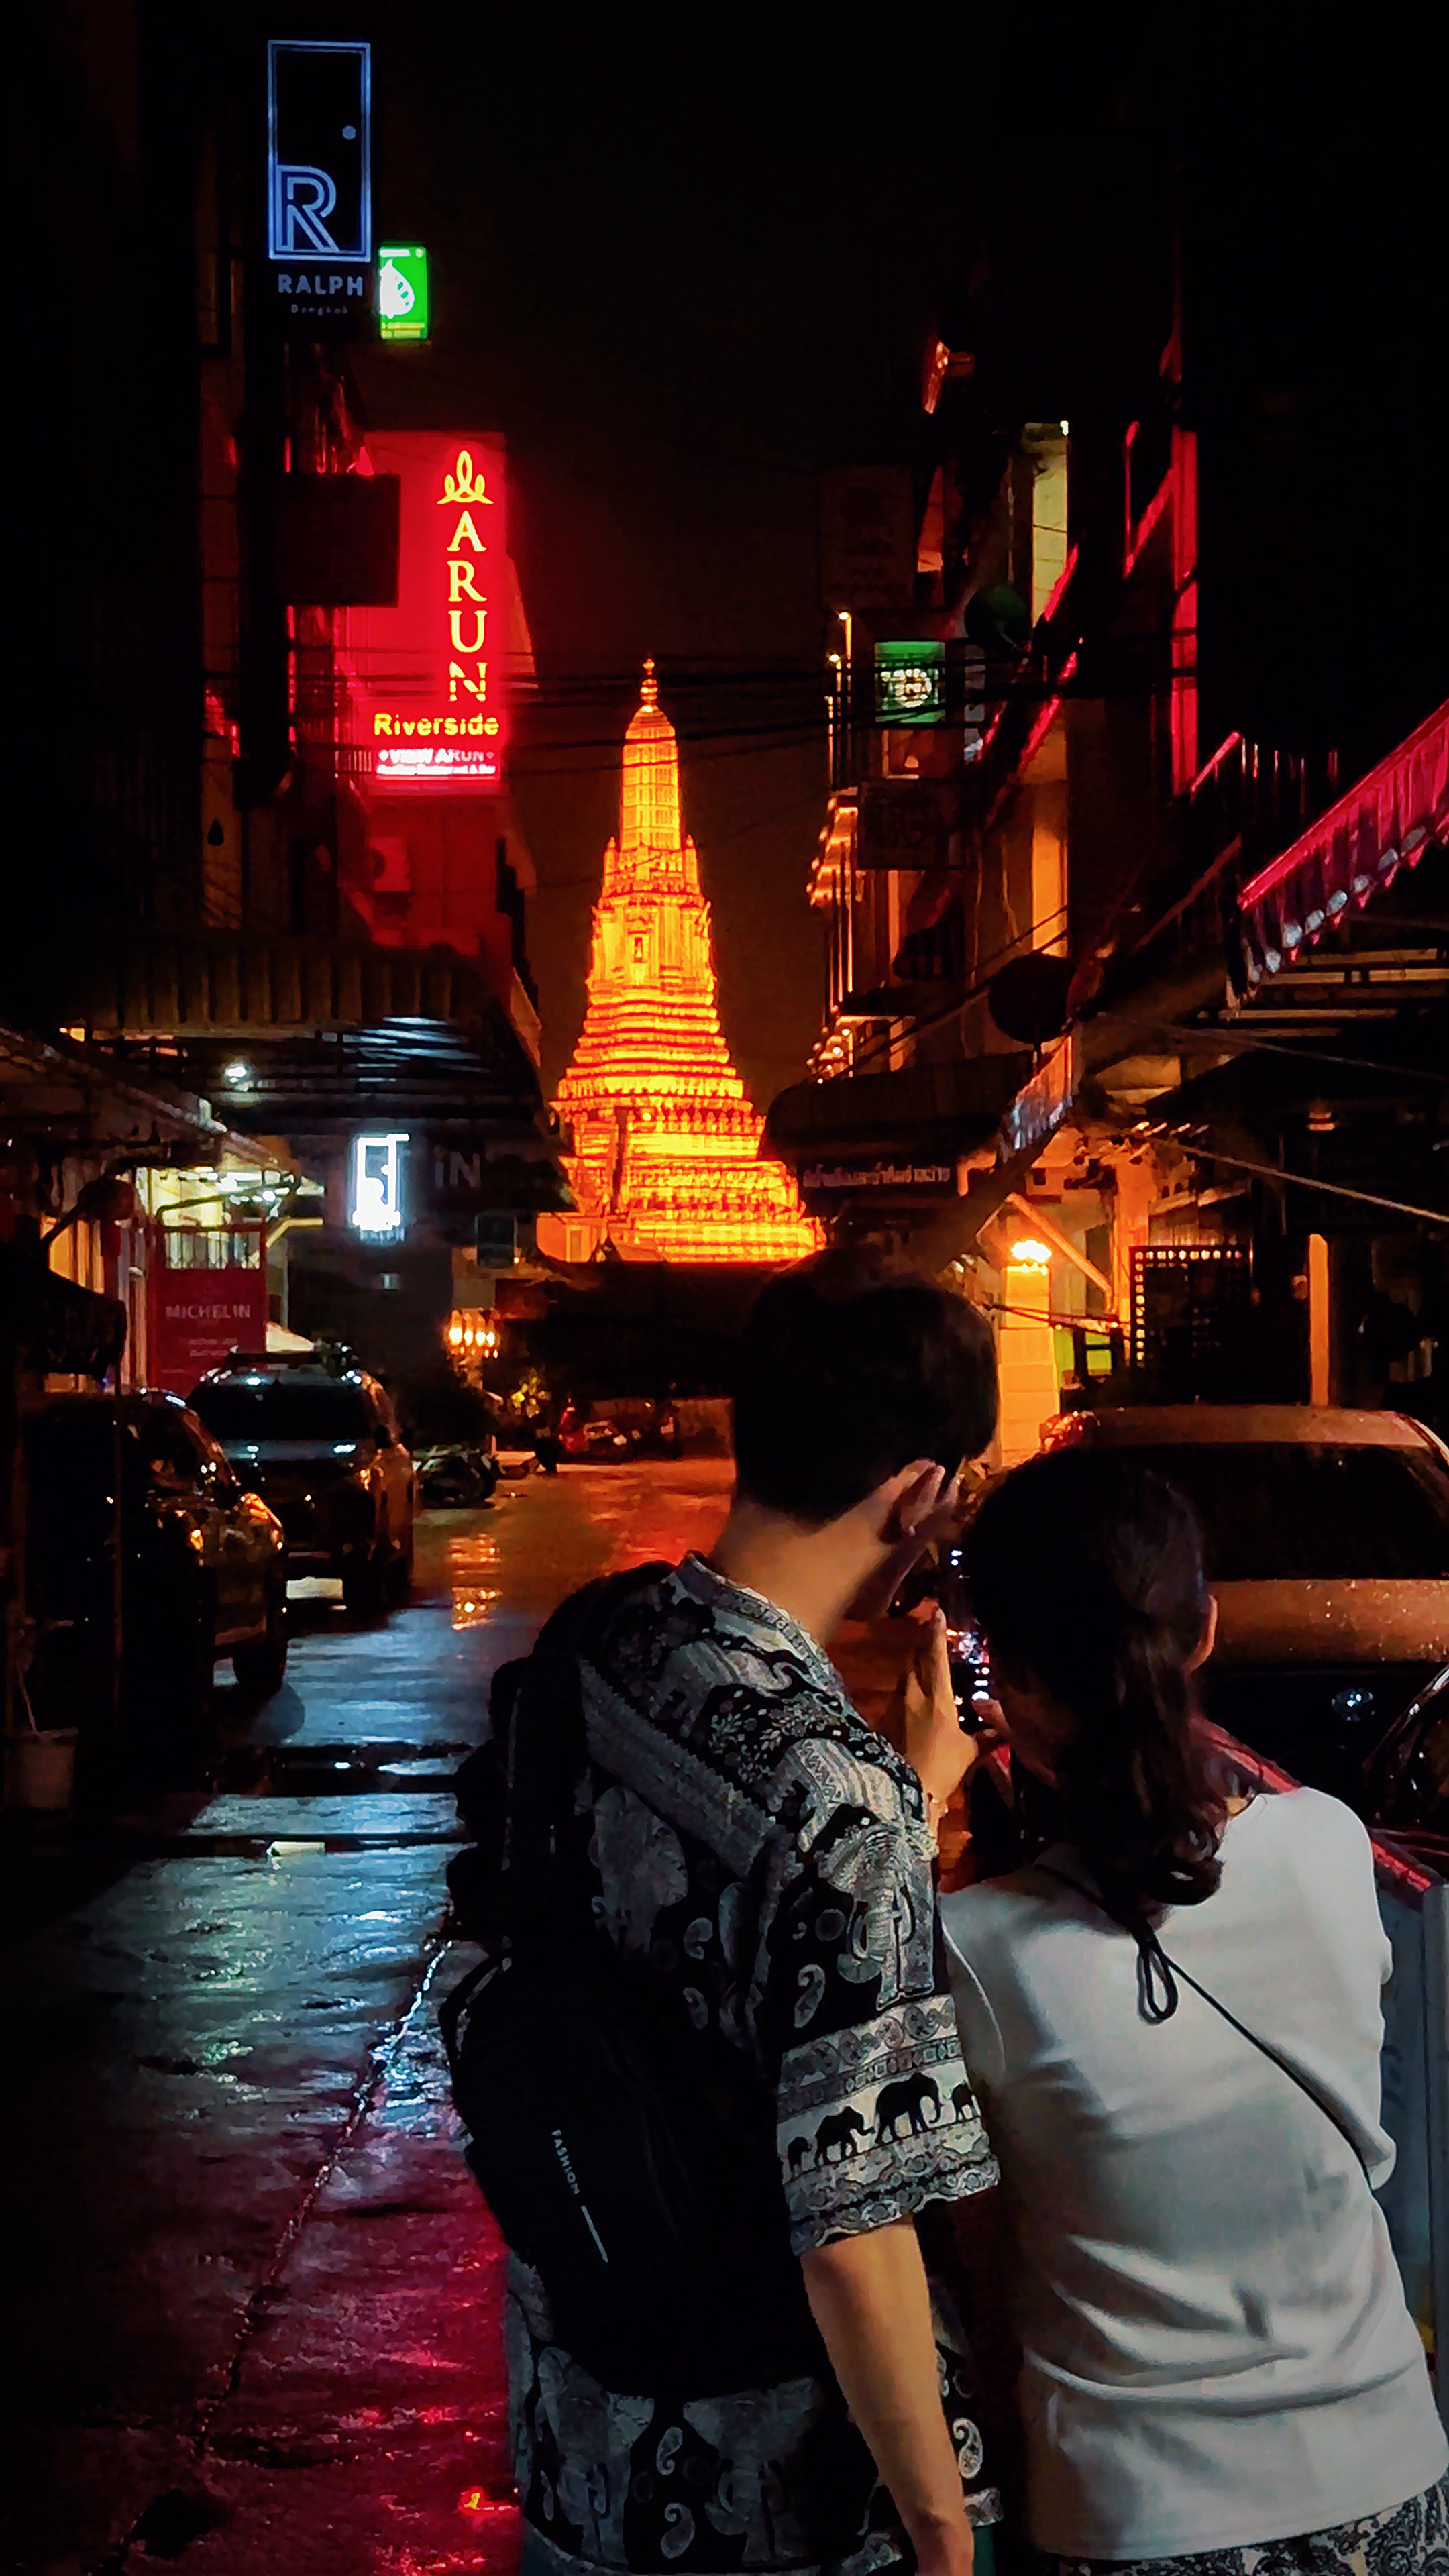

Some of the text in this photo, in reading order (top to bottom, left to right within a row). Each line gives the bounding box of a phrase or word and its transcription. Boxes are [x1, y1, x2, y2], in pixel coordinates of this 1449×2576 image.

[276, 164, 339, 252] R
[277, 274, 364, 297] RALPH
[447, 510, 488, 702] ARUN
[374, 712, 500, 736] Riverside
[165, 1303, 252, 1320] MICHELIN
[551, 2129, 581, 2196] FASHION
